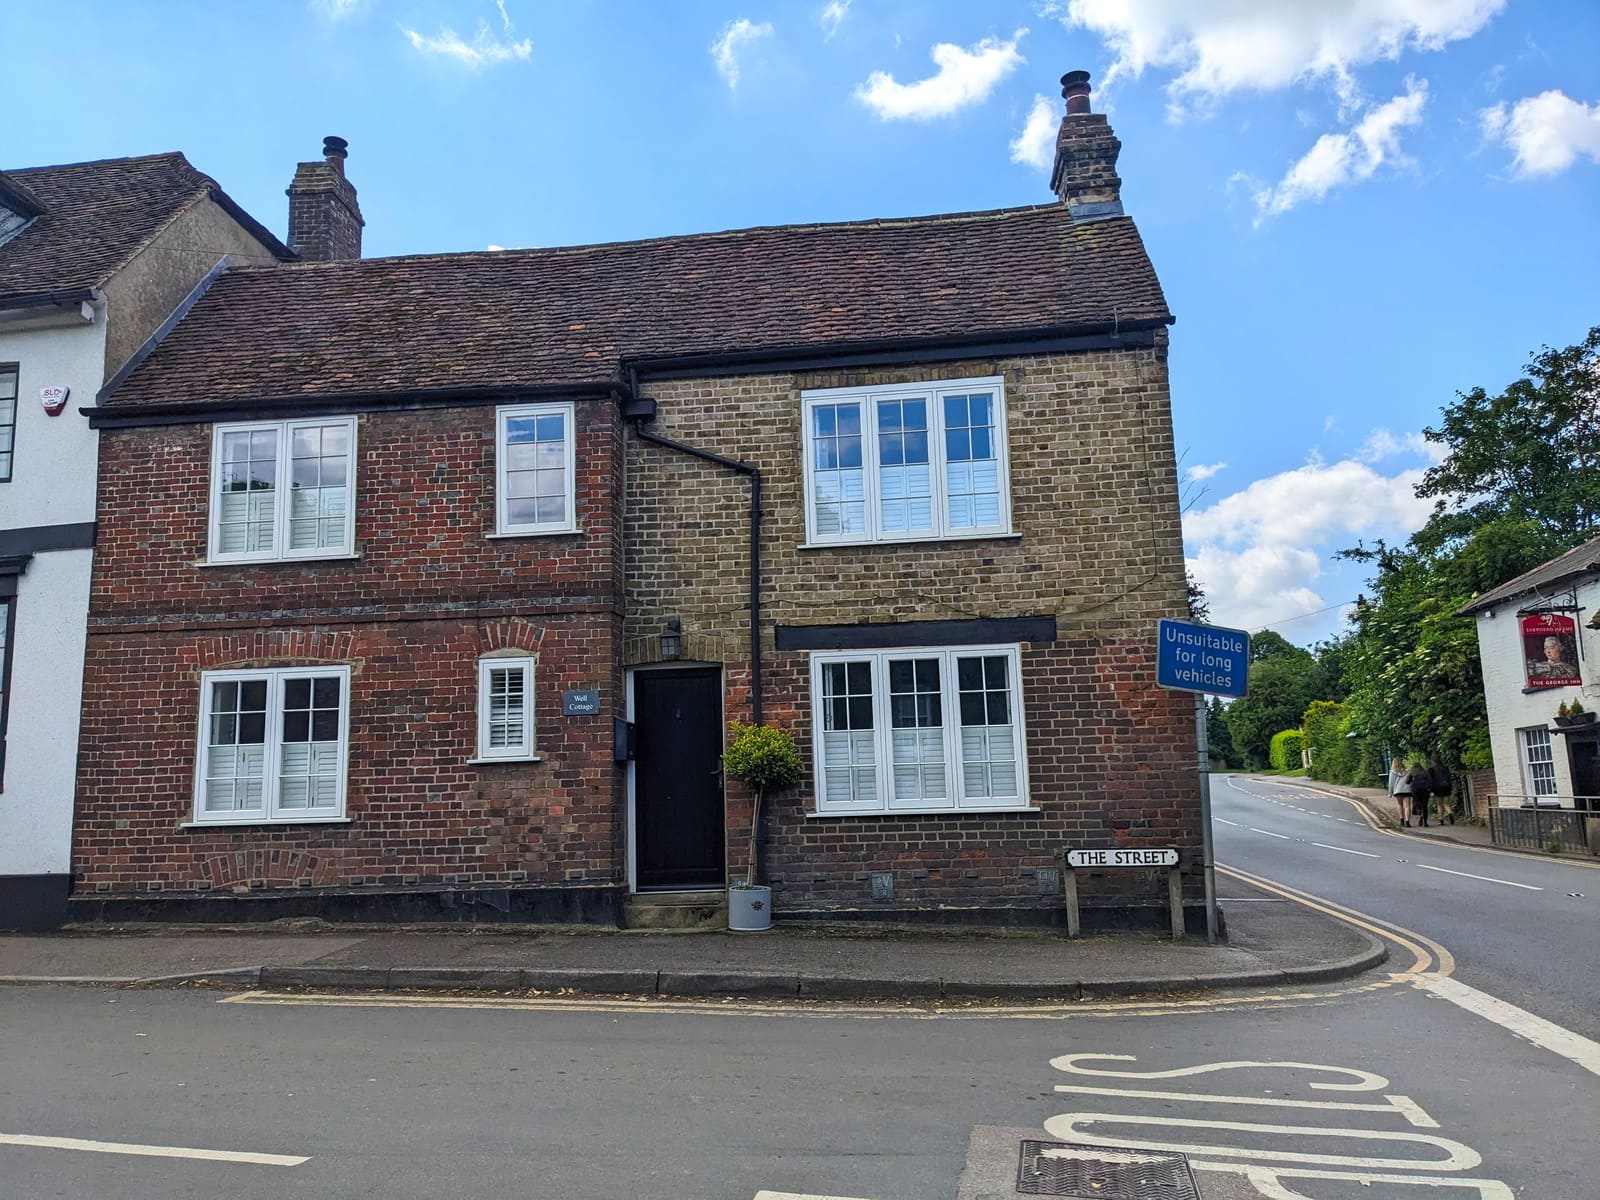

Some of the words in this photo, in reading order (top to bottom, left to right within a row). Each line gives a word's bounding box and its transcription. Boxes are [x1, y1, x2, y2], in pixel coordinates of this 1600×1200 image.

[1166, 627, 1243, 653] Unsuitable
[1175, 647, 1196, 663] for
[1201, 651, 1232, 672] long
[1175, 668, 1232, 688] vehicles
[568, 703, 594, 711] Cottage
[1077, 851, 1107, 864] THE
[1115, 851, 1169, 864] STREET
